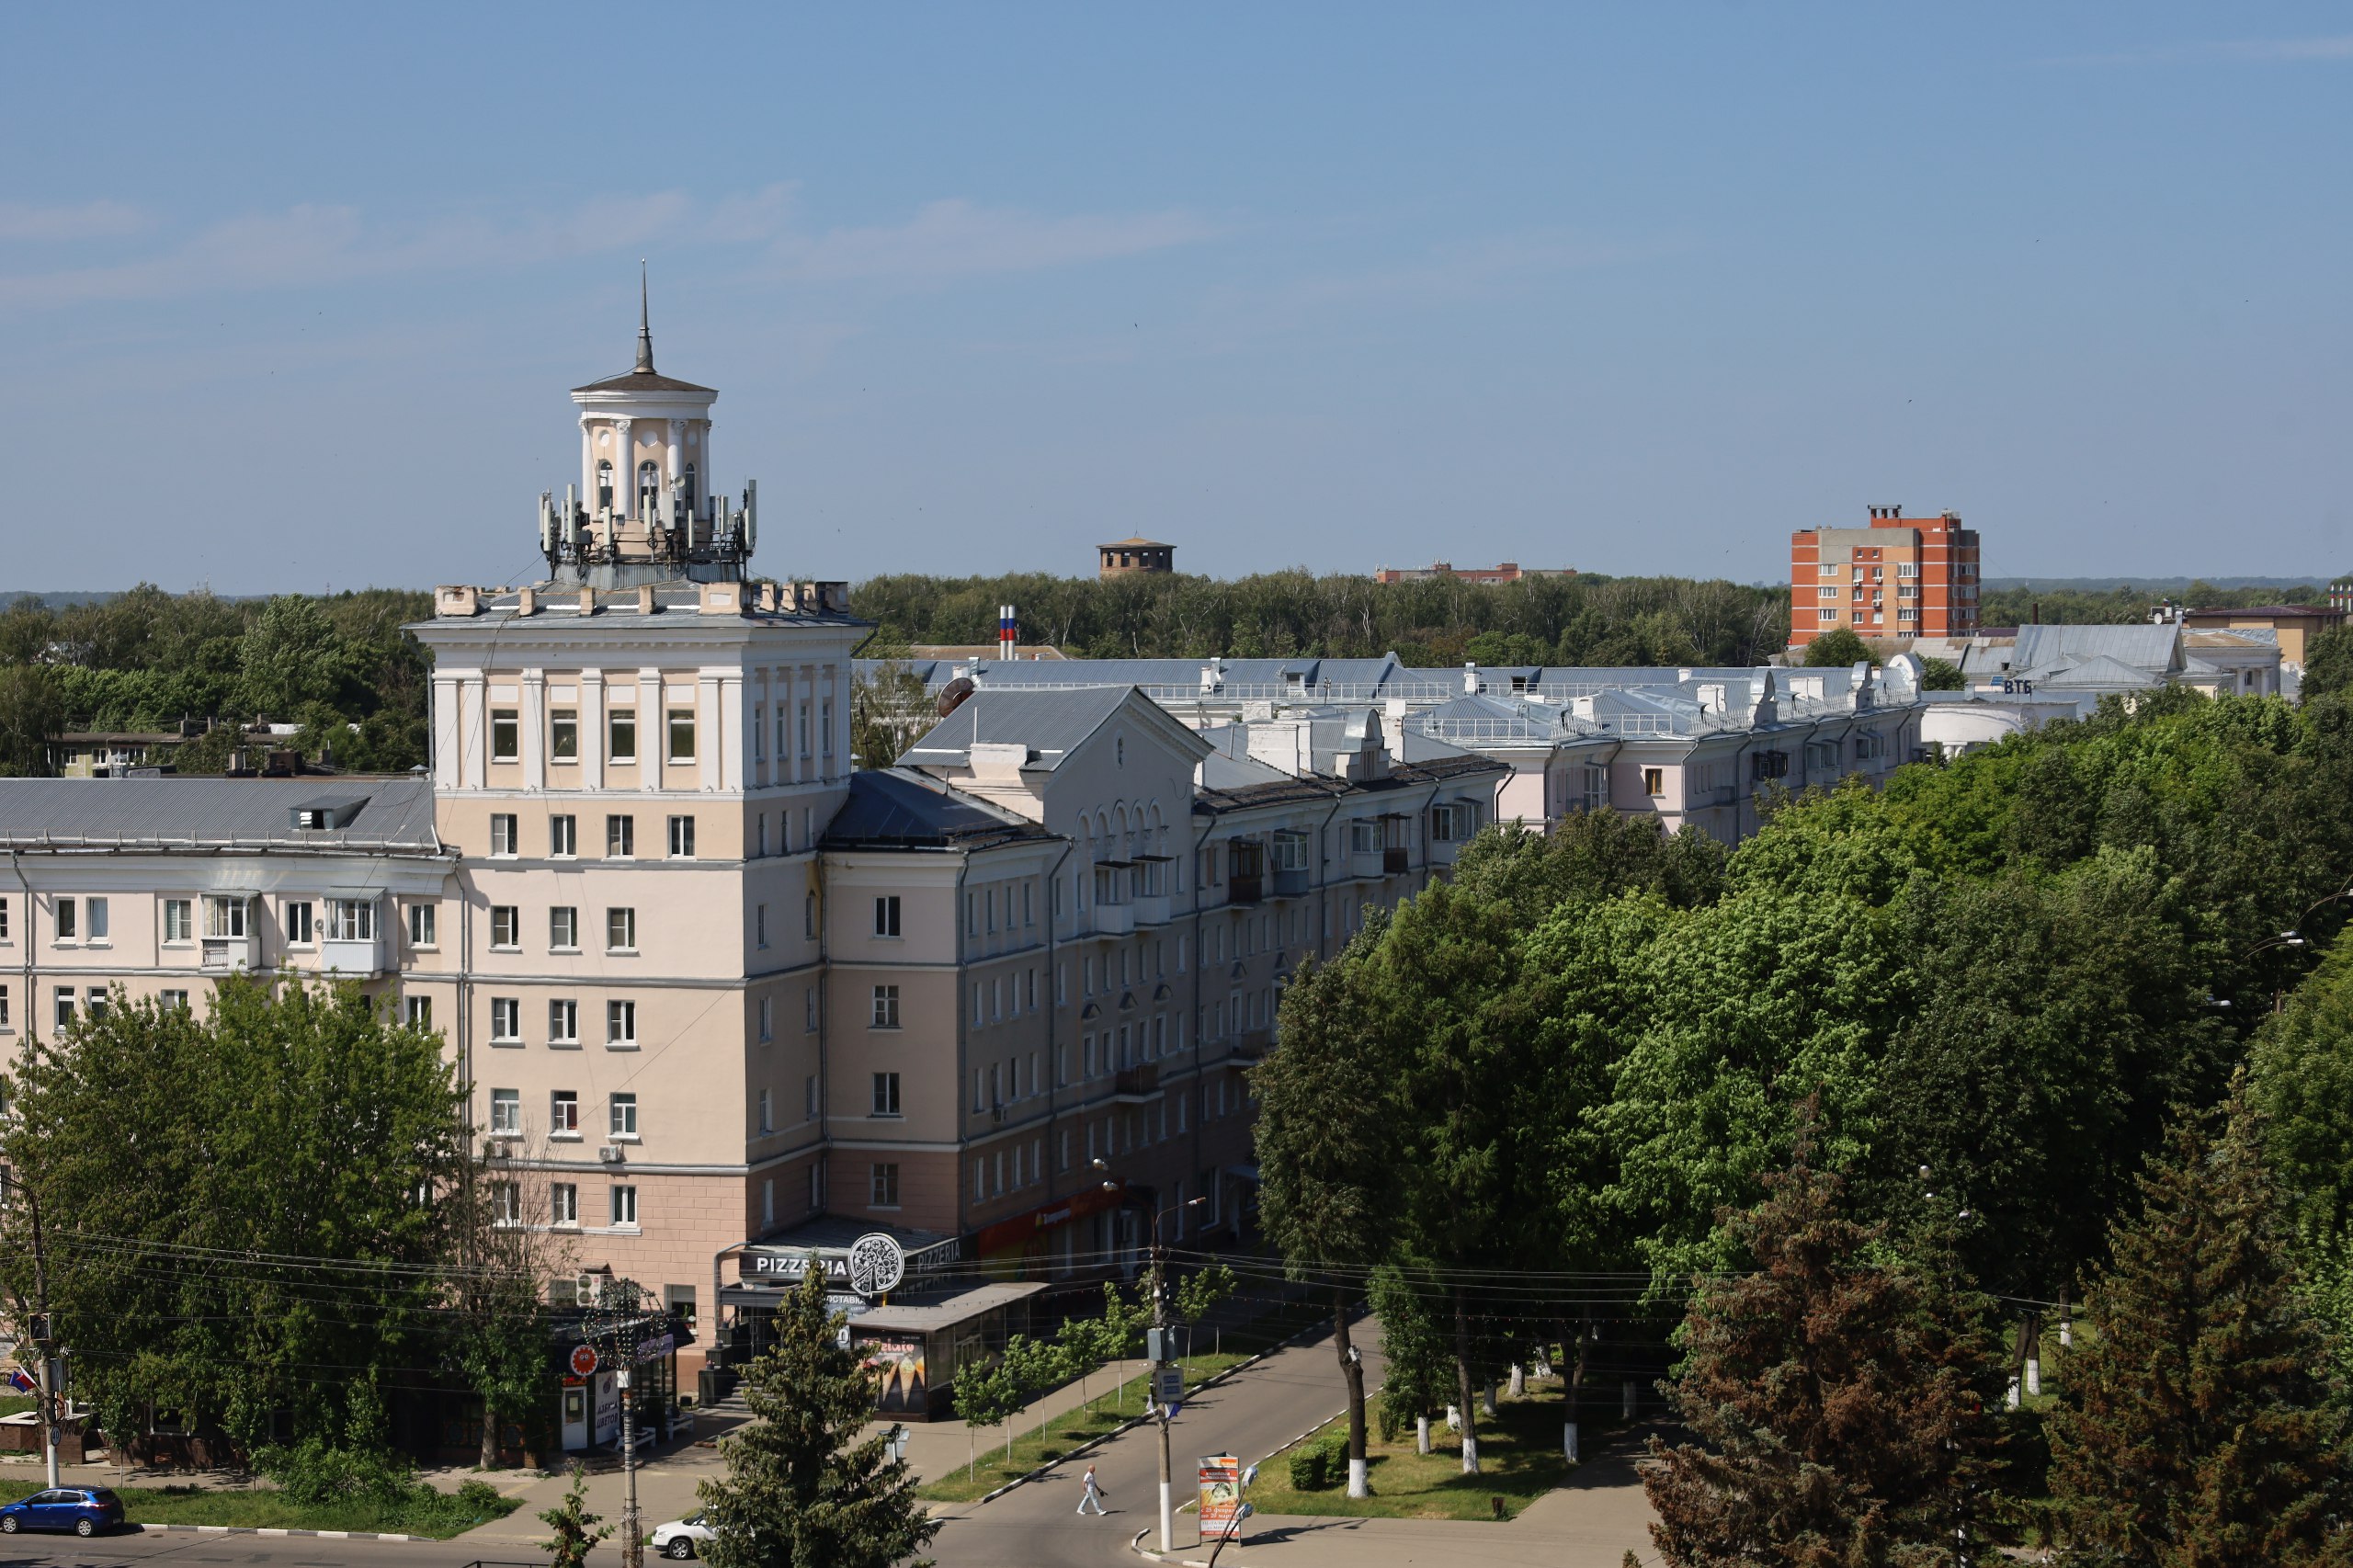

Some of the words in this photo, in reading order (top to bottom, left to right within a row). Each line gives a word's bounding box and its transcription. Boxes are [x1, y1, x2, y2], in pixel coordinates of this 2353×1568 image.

[2005, 680, 2031, 695] ВТБ
[917, 1241, 961, 1274] PIZZERIA
[824, 1295, 866, 1304] ОСТАВКА
[597, 1413, 618, 1428] ЦВЕТОВ
